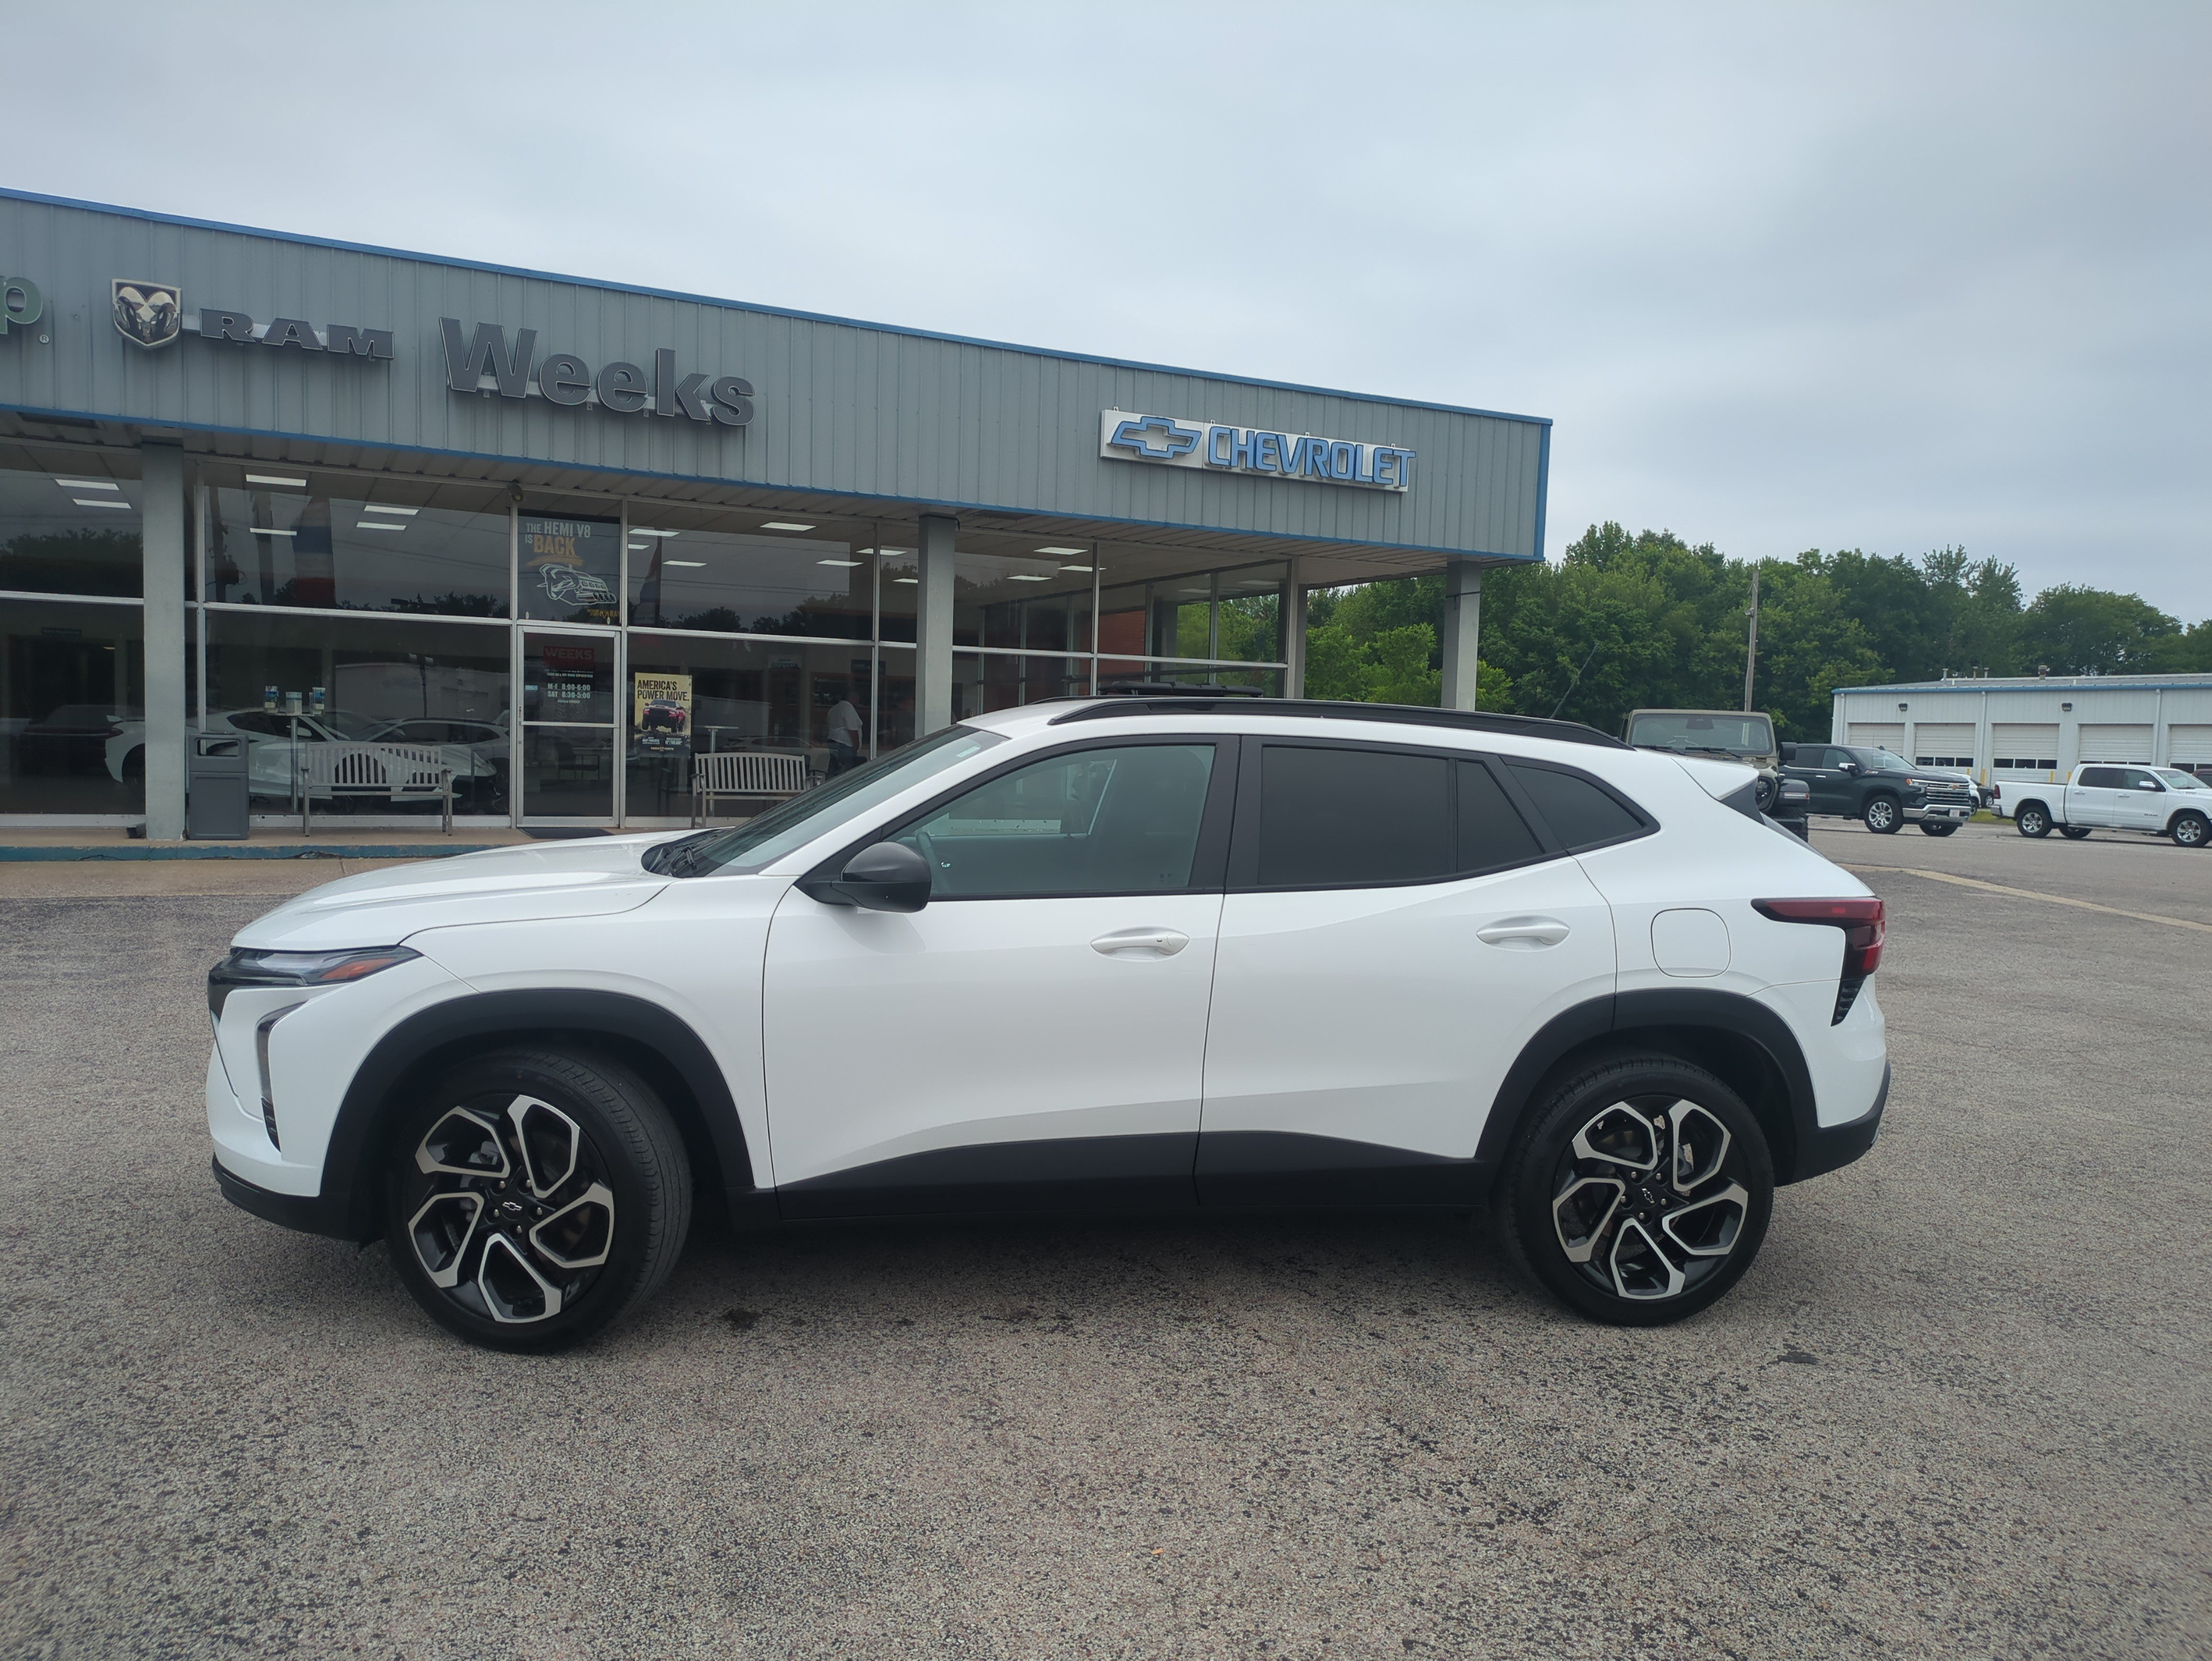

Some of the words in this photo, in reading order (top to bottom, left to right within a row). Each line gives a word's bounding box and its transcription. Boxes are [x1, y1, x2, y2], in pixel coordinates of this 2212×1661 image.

[200, 308, 394, 359] RAM
[438, 317, 756, 426] Weeks
[1208, 426, 1416, 487] CHEVROLET
[526, 523, 541, 533] THE
[544, 521, 573, 536] HEMI
[577, 524, 591, 538] V8
[525, 534, 533, 543] IS
[534, 534, 576, 556] BACK
[544, 647, 593, 660] WEEKS
[637, 679, 677, 690] AMERICA'S
[638, 689, 664, 699] POWER
[666, 691, 689, 701] MOVE.
